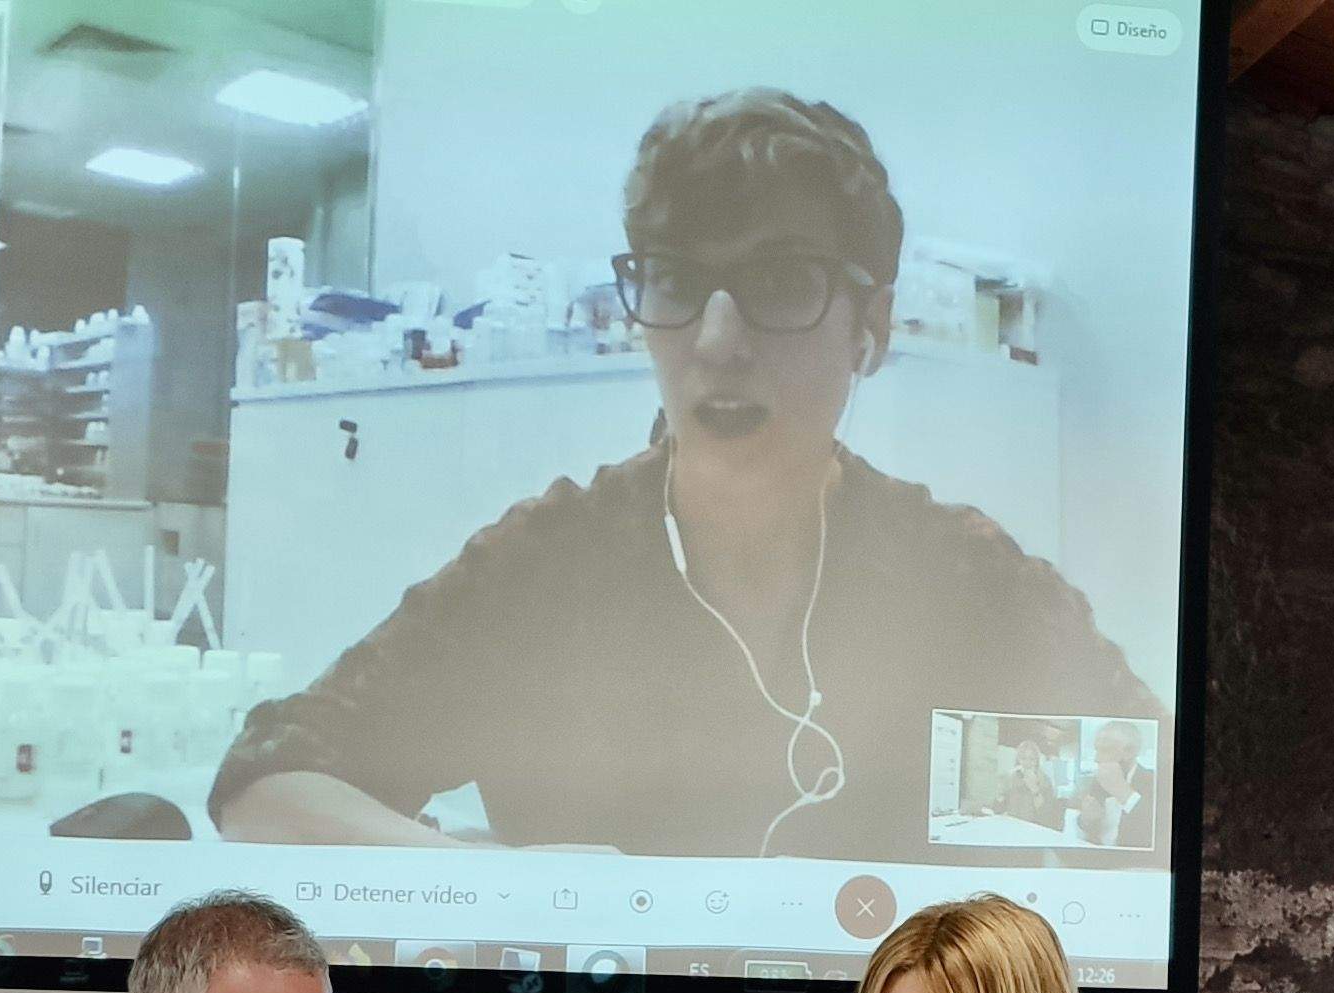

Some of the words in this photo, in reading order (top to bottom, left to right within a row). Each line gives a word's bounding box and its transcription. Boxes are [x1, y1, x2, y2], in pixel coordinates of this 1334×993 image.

[1117, 21, 1167, 39] Diseño
[71, 875, 163, 896] Silenciar
[334, 883, 415, 904] Detener
[421, 884, 478, 905] vídeo
[1077, 967, 1116, 983] 12:26
